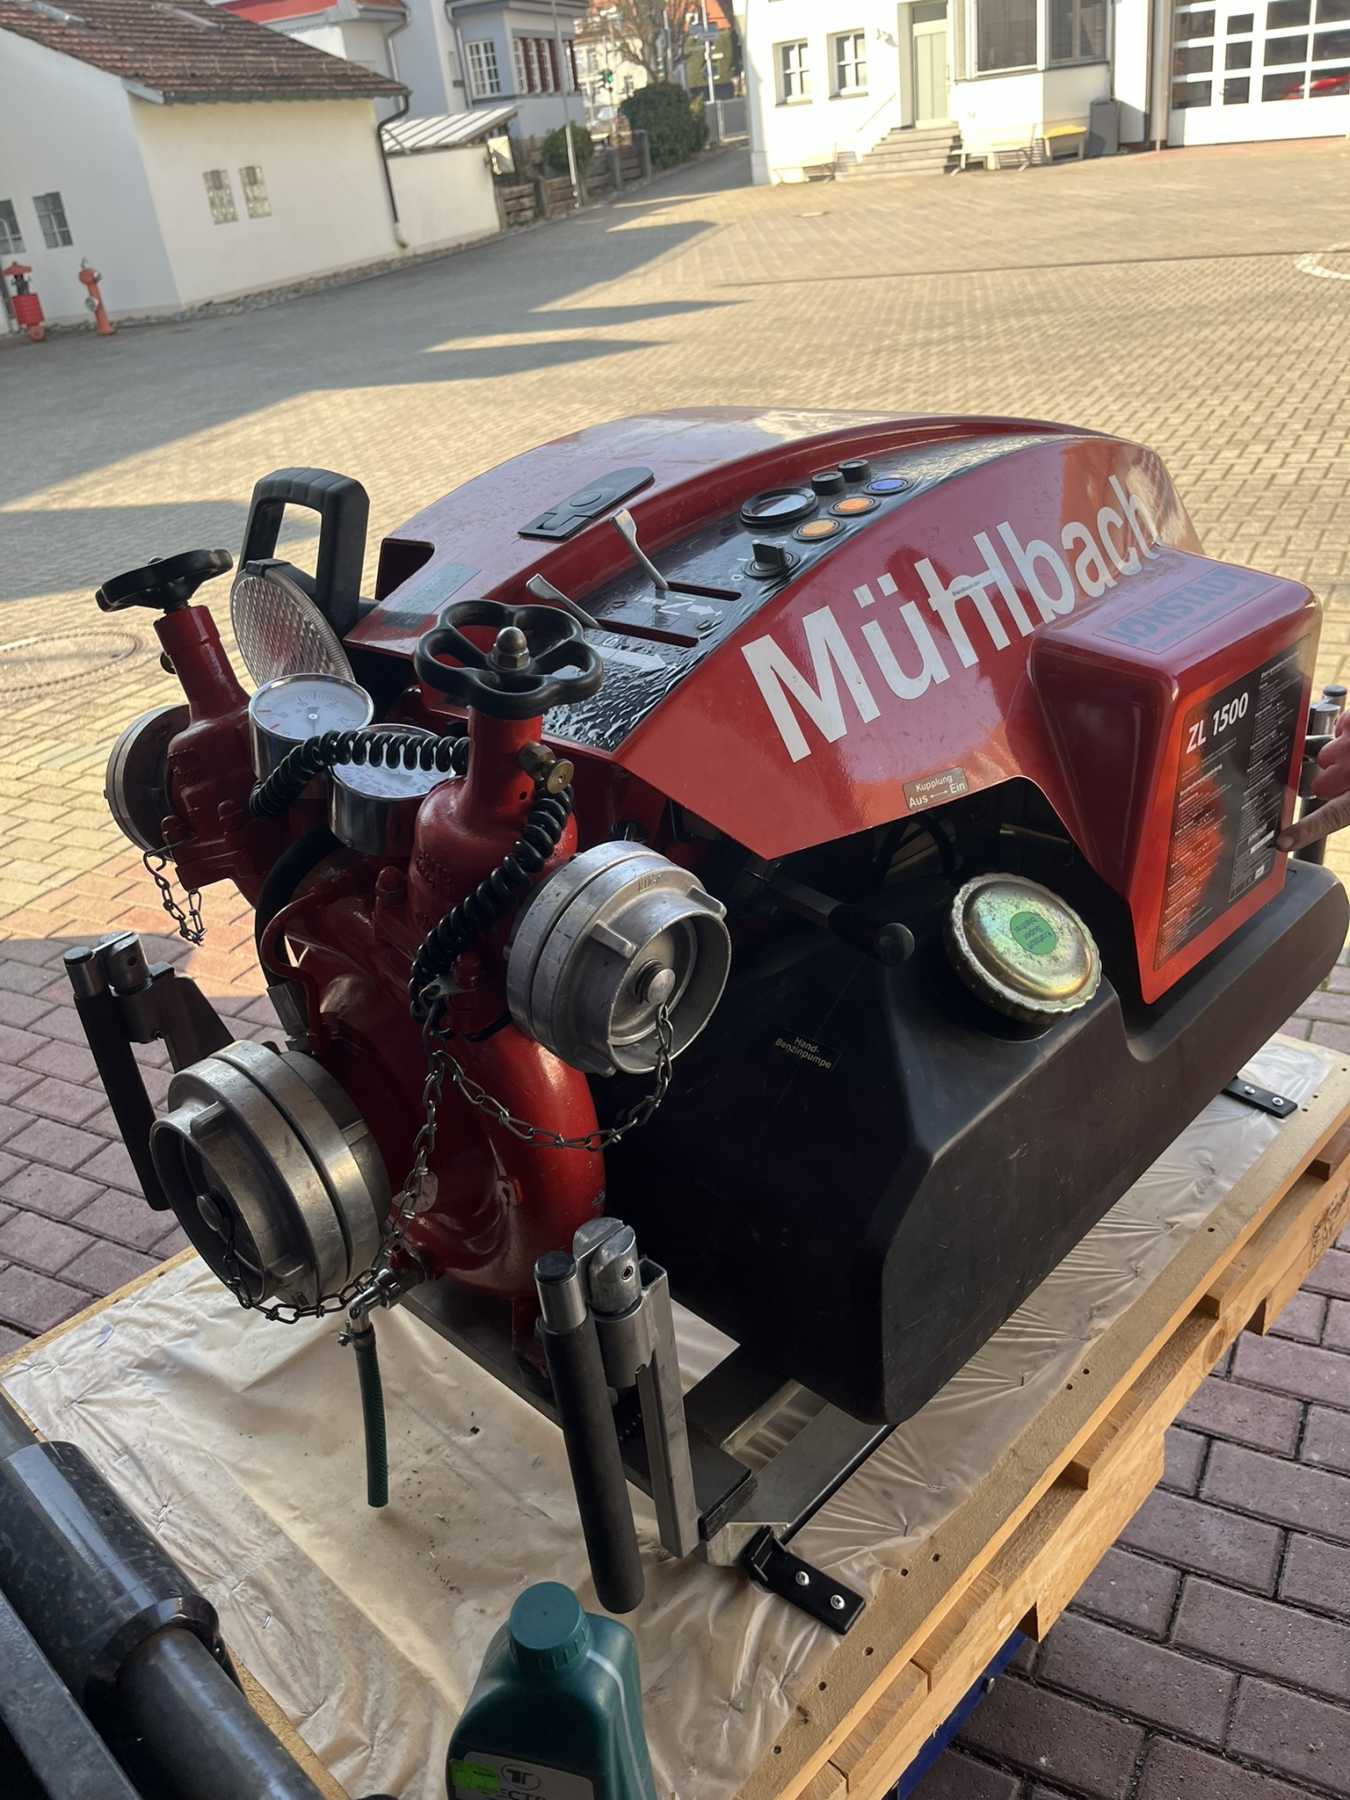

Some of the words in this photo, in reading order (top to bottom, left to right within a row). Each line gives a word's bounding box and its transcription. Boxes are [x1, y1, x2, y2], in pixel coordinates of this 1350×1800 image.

[741, 474, 1160, 763] Mühlbach
[1186, 720, 1206, 754] ZL
[1213, 692, 1248, 736] 1500
[909, 795, 929, 807] Aus
[949, 782, 966, 794] Ein
[915, 775, 953, 792] Kupplung
[775, 1038, 832, 1069] Benzinpumpe
